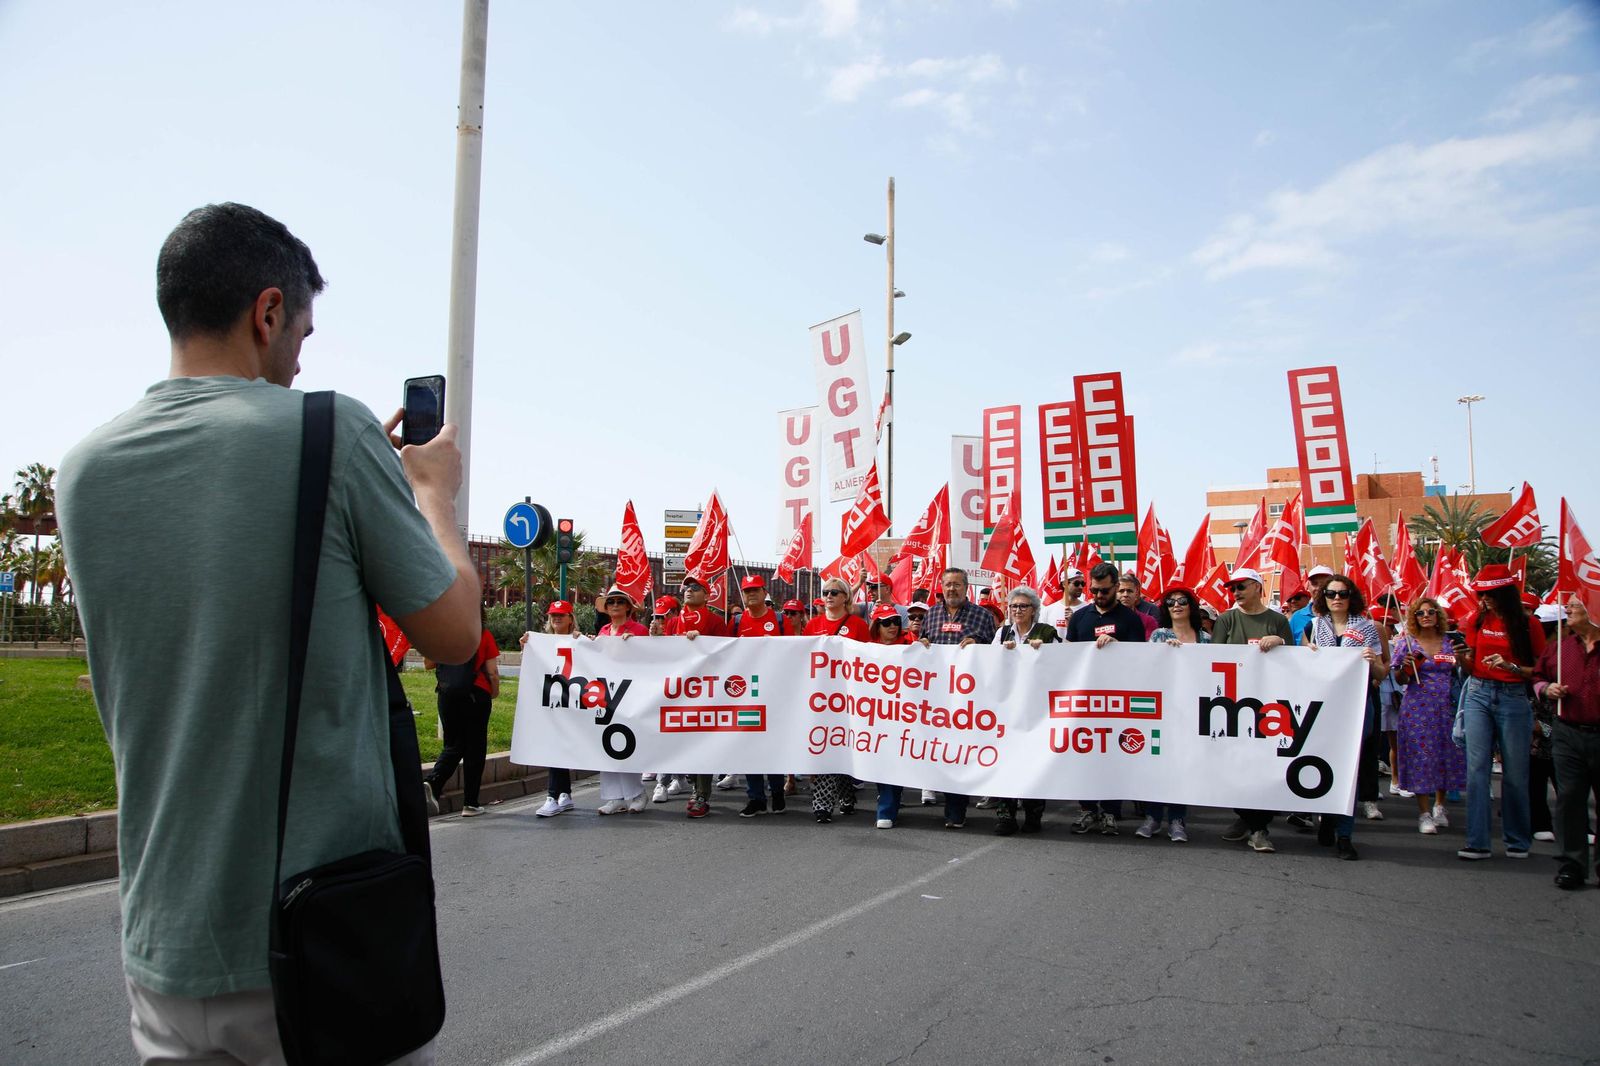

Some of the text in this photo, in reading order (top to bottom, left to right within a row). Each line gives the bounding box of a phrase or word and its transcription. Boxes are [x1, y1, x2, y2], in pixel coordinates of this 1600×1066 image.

[821, 323, 861, 470] UGT
[1081, 379, 1125, 512] CCOO
[1296, 372, 1345, 503] CCOO
[784, 414, 811, 530] UGT
[834, 474, 868, 491] ALMER
[1044, 407, 1076, 519] CCOO
[663, 676, 719, 699] UGT
[810, 651, 976, 694] Proteger lo
[665, 711, 732, 727] CCOO
[808, 691, 1005, 738] conquistado,
[1054, 695, 1124, 712] CCOO
[808, 725, 999, 767] ganar futuro
[1050, 727, 1113, 753] UGT
